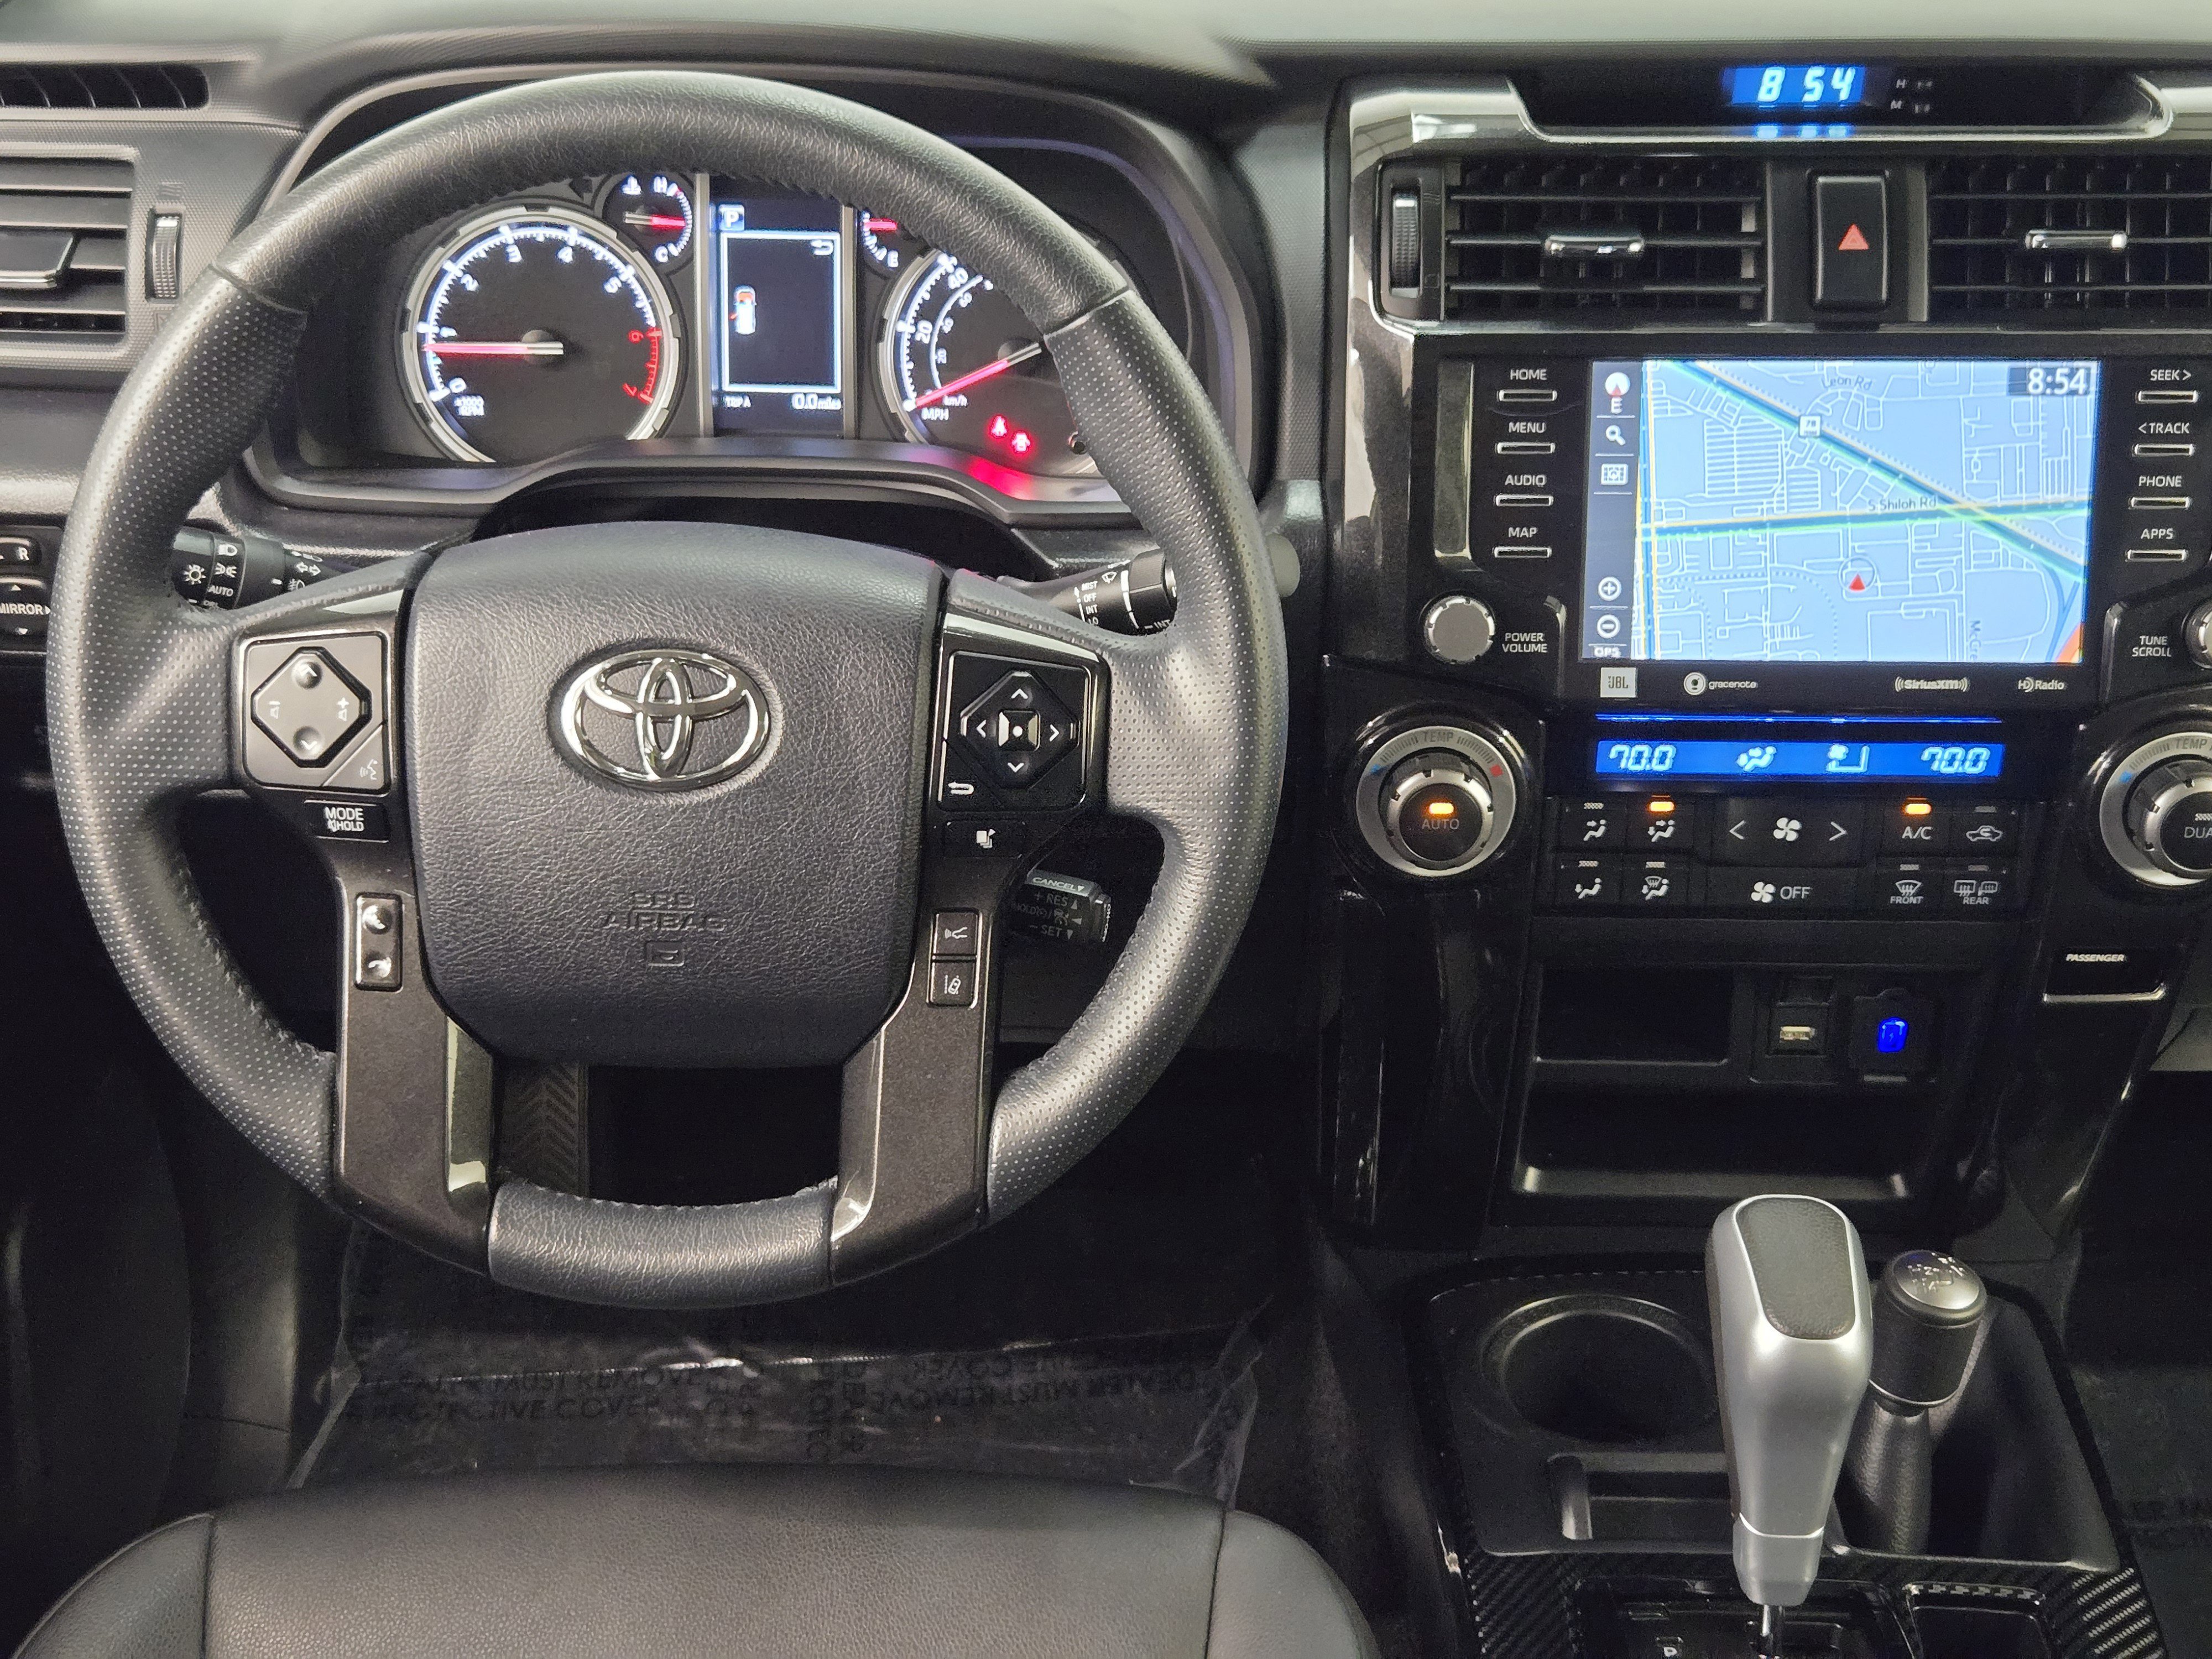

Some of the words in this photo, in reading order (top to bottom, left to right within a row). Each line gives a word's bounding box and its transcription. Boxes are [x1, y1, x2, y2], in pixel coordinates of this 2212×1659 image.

[654, 177, 667, 192] H
[723, 211, 739, 227] P
[506, 244, 523, 263] 3
[557, 246, 574, 263] 4
[888, 251, 899, 267] E
[460, 274, 479, 291] 2
[604, 276, 622, 293] 5
[948, 267, 968, 289] 40
[628, 330, 644, 342] 6
[915, 320, 932, 344] 20
[1510, 369, 1547, 380] HOME
[449, 378, 466, 393] 0
[1854, 375, 1872, 390] Rd
[2028, 368, 2088, 395] 8:54
[623, 383, 637, 396] 7
[743, 395, 752, 408] A
[942, 394, 968, 406] km/h
[921, 408, 950, 420] MPH
[1509, 422, 1546, 434] MENU
[1505, 474, 1546, 488] AUDIO
[2138, 476, 2183, 487] PHONE
[1869, 499, 1876, 511] S
[1880, 497, 1916, 510] Shiloh
[1920, 494, 1937, 508] Rd
[1508, 527, 1538, 538] MAP
[2141, 528, 2174, 540] APPS
[19, 546, 29, 561] R
[208, 585, 233, 597] AUTO
[1082, 581, 1098, 591] MIST
[1083, 593, 1097, 603] OFF
[1086, 604, 1098, 615] INT
[1505, 632, 1544, 642] POWER
[2139, 636, 2168, 646] TUNE
[1502, 643, 1548, 654] VOLUME
[2132, 646, 2172, 658] SCROLL
[1608, 676, 1629, 689] JBL
[1708, 681, 1757, 691] gracenote
[1422, 731, 1454, 743] TEMP
[2176, 738, 2207, 751] TEMP
[1610, 744, 1676, 771] 70.0
[1921, 747, 1991, 774] 70.0
[325, 806, 364, 821] MODE
[1421, 818, 1460, 831] AUTO
[1902, 826, 1933, 840] A/C
[1032, 877, 1076, 891] CANCEL
[1046, 893, 1069, 906] RES
[1780, 886, 1811, 900] OFF
[1890, 896, 1924, 905] FRONT
[1963, 896, 1990, 905] REAR
[1041, 924, 1063, 937] SET
[2066, 954, 2126, 963] PASSENGER
